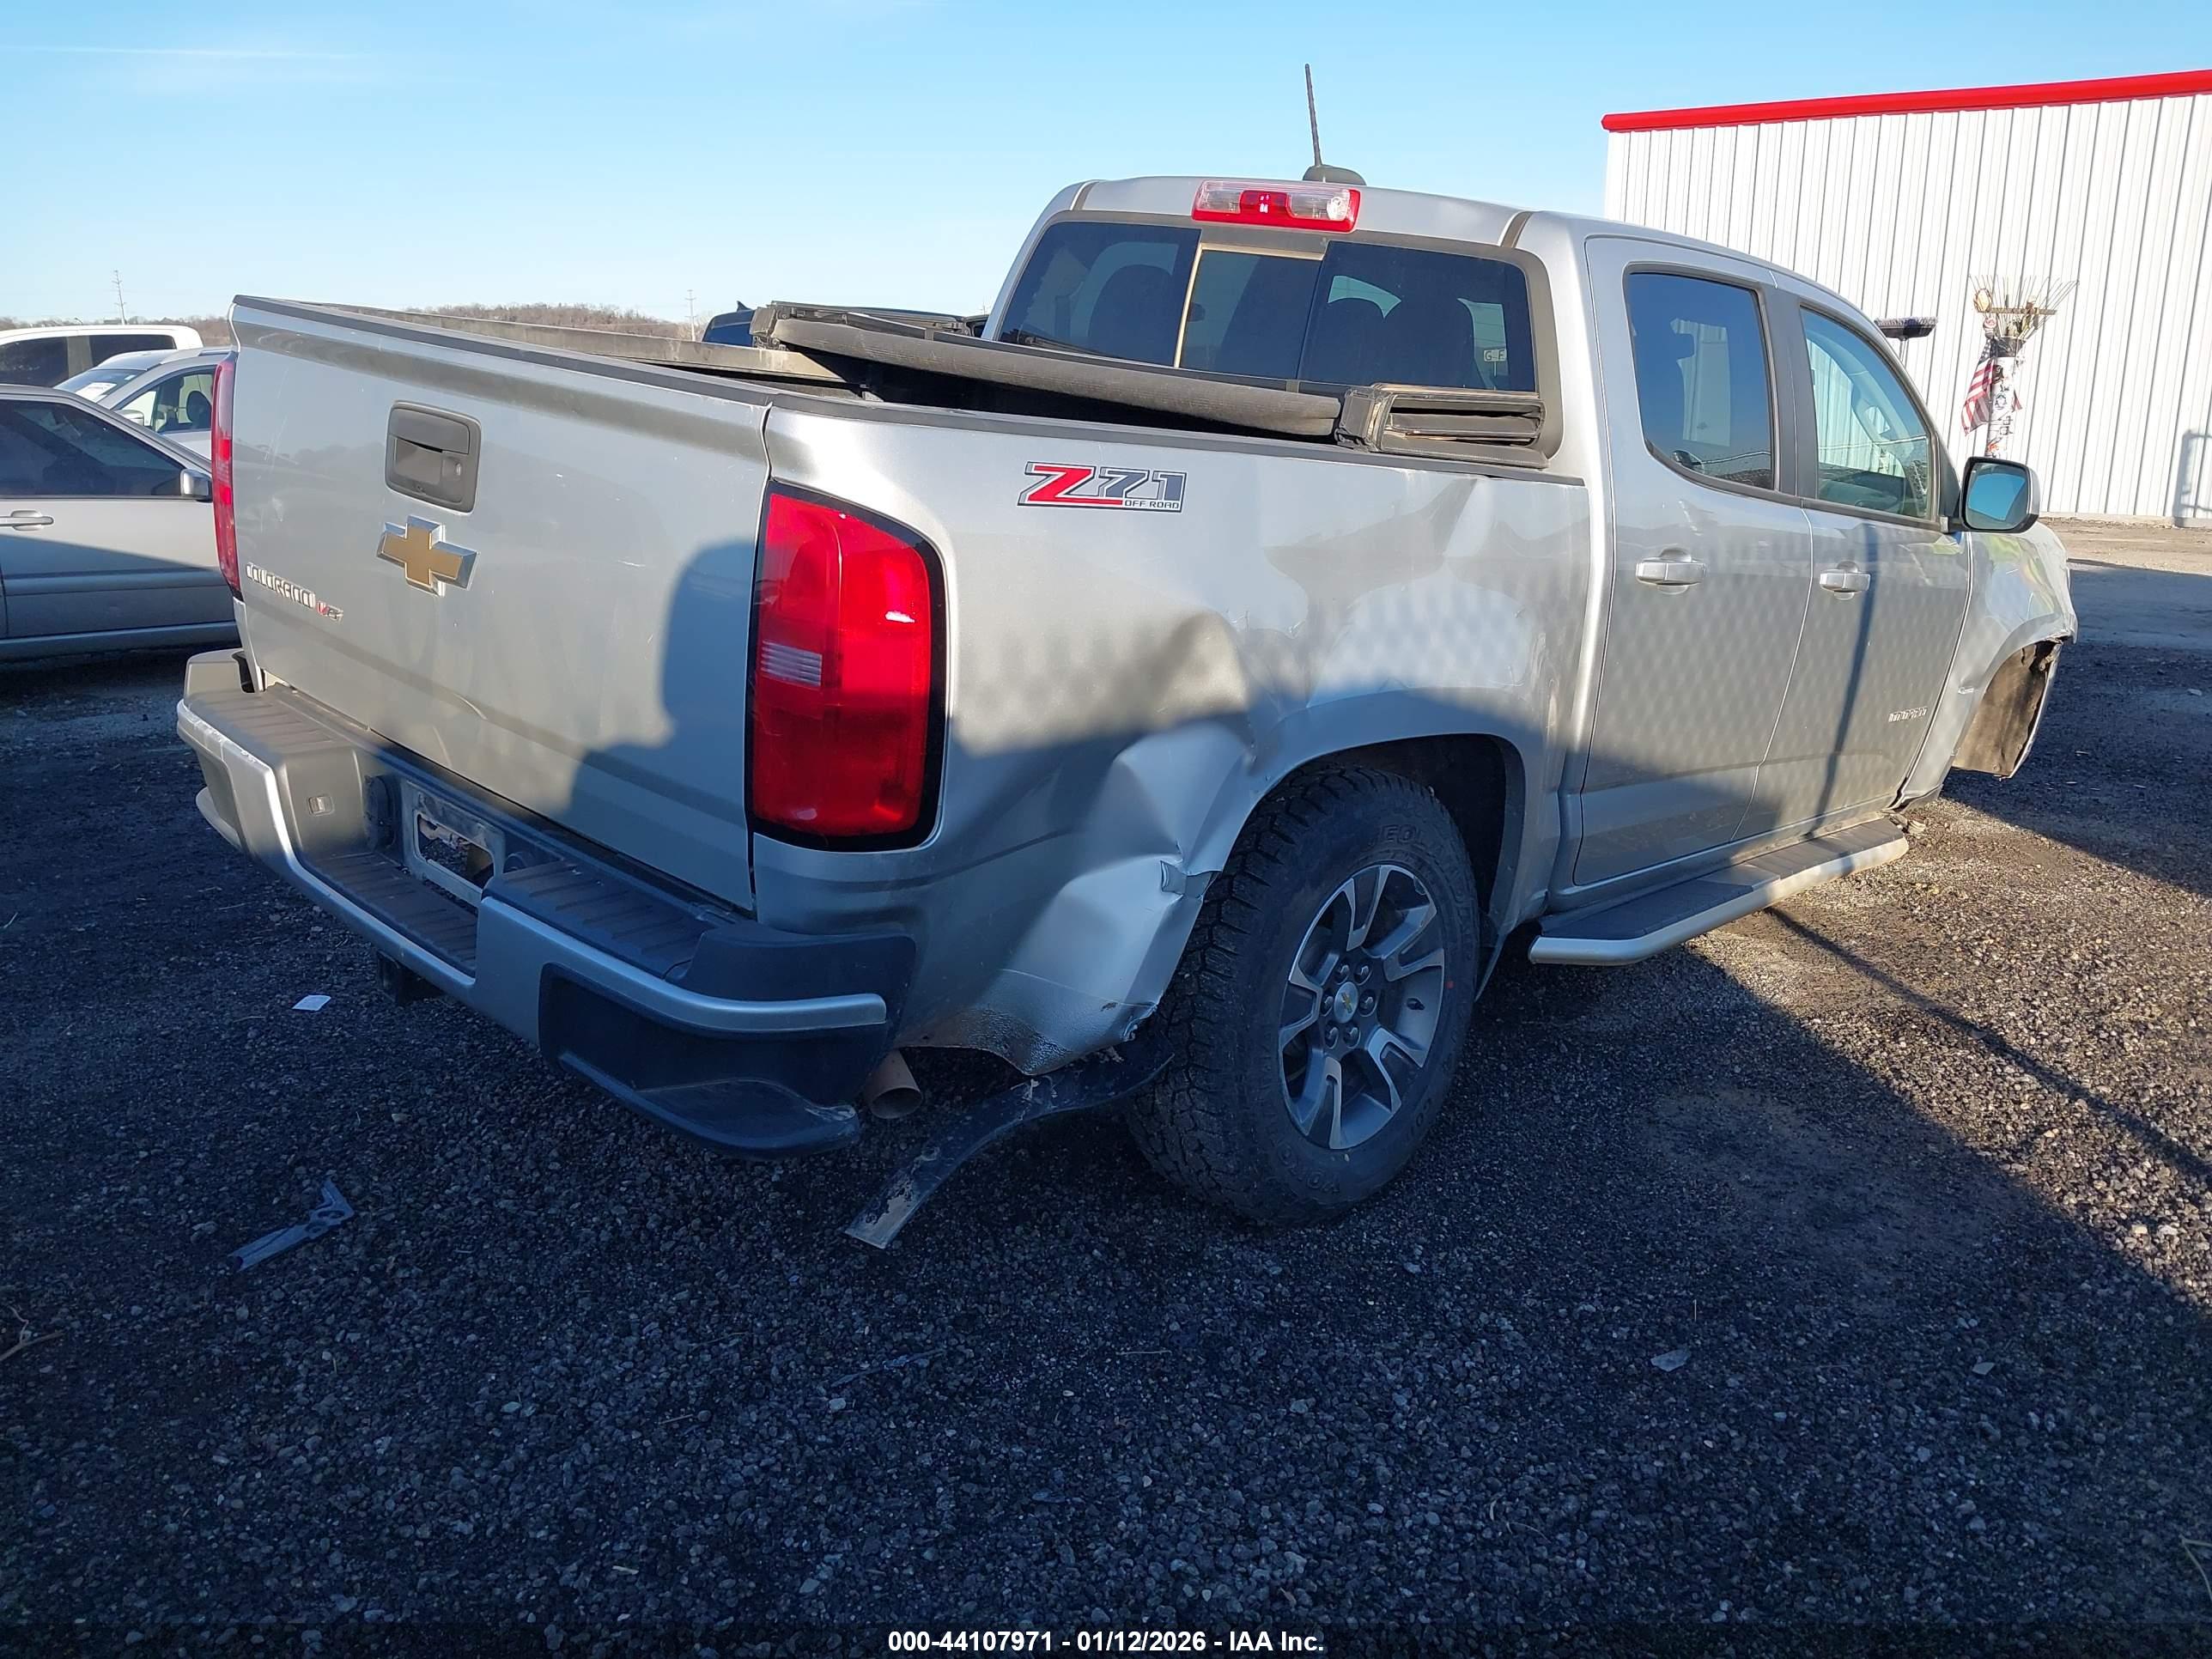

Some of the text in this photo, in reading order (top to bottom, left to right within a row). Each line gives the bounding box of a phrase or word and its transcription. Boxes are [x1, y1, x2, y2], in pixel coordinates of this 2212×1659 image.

[1017, 461, 1188, 513] Z71
[1124, 499, 1181, 509] OFF ROAD
